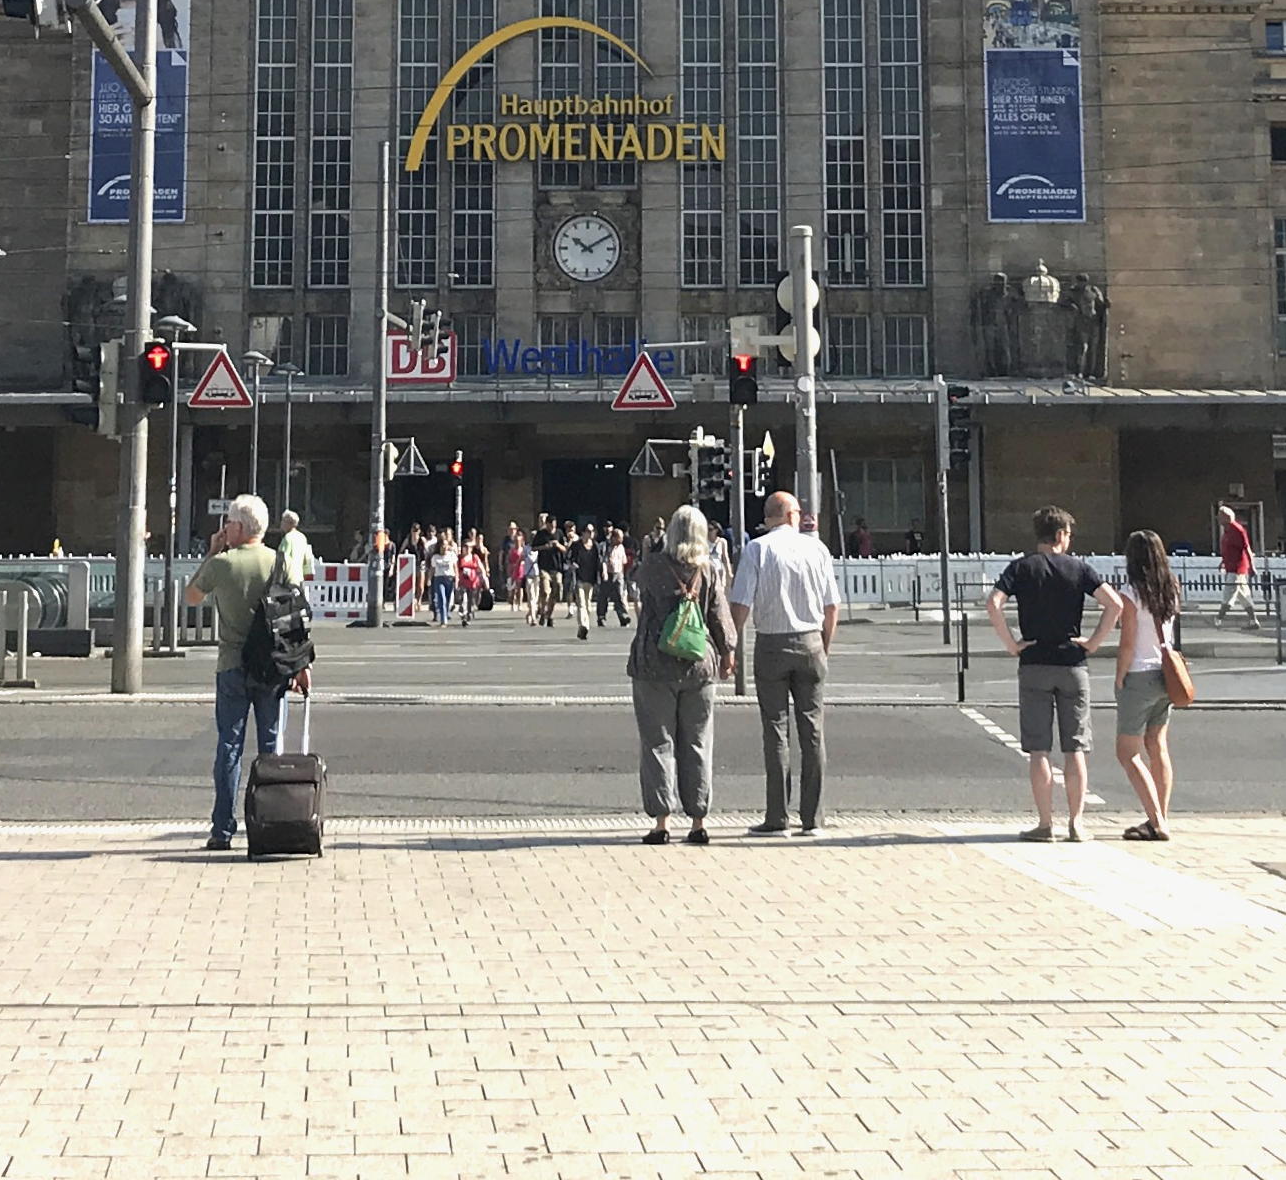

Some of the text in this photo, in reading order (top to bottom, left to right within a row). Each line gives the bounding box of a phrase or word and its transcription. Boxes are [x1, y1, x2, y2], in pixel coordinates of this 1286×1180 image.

[98, 103, 120, 114] HIER
[501, 93, 674, 120] Hauptbahnhof
[993, 113, 1018, 121] ALLES
[446, 123, 726, 161] PROMENADEN
[483, 338, 675, 376] Westhale
